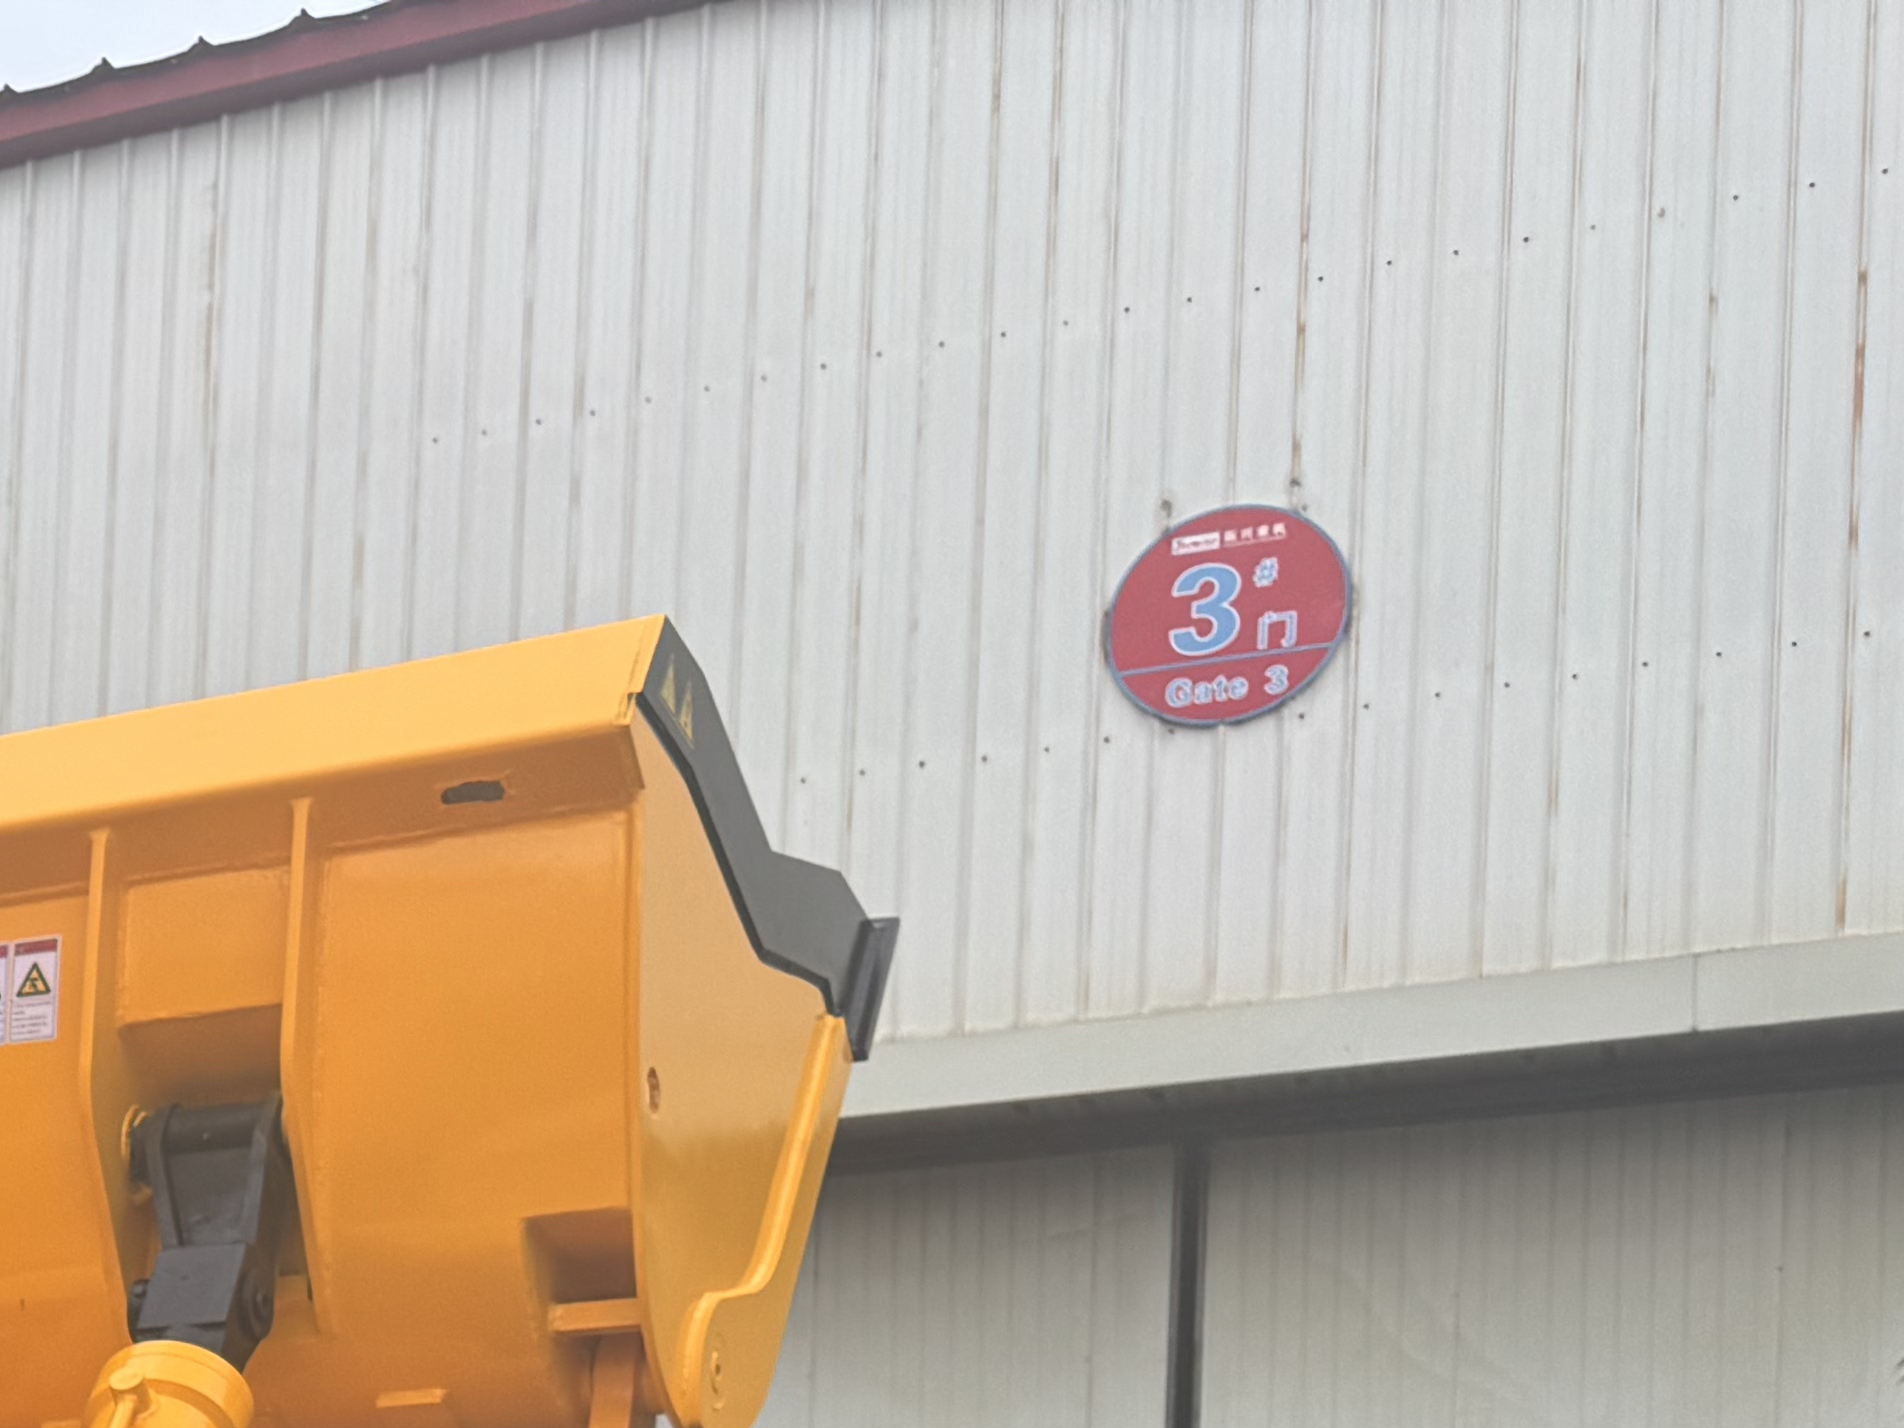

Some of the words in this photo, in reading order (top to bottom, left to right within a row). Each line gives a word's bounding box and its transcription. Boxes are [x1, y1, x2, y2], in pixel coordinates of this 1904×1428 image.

[1168, 562, 1242, 656] 3
[1165, 674, 1249, 708] Gate
[1264, 664, 1289, 695] 3
